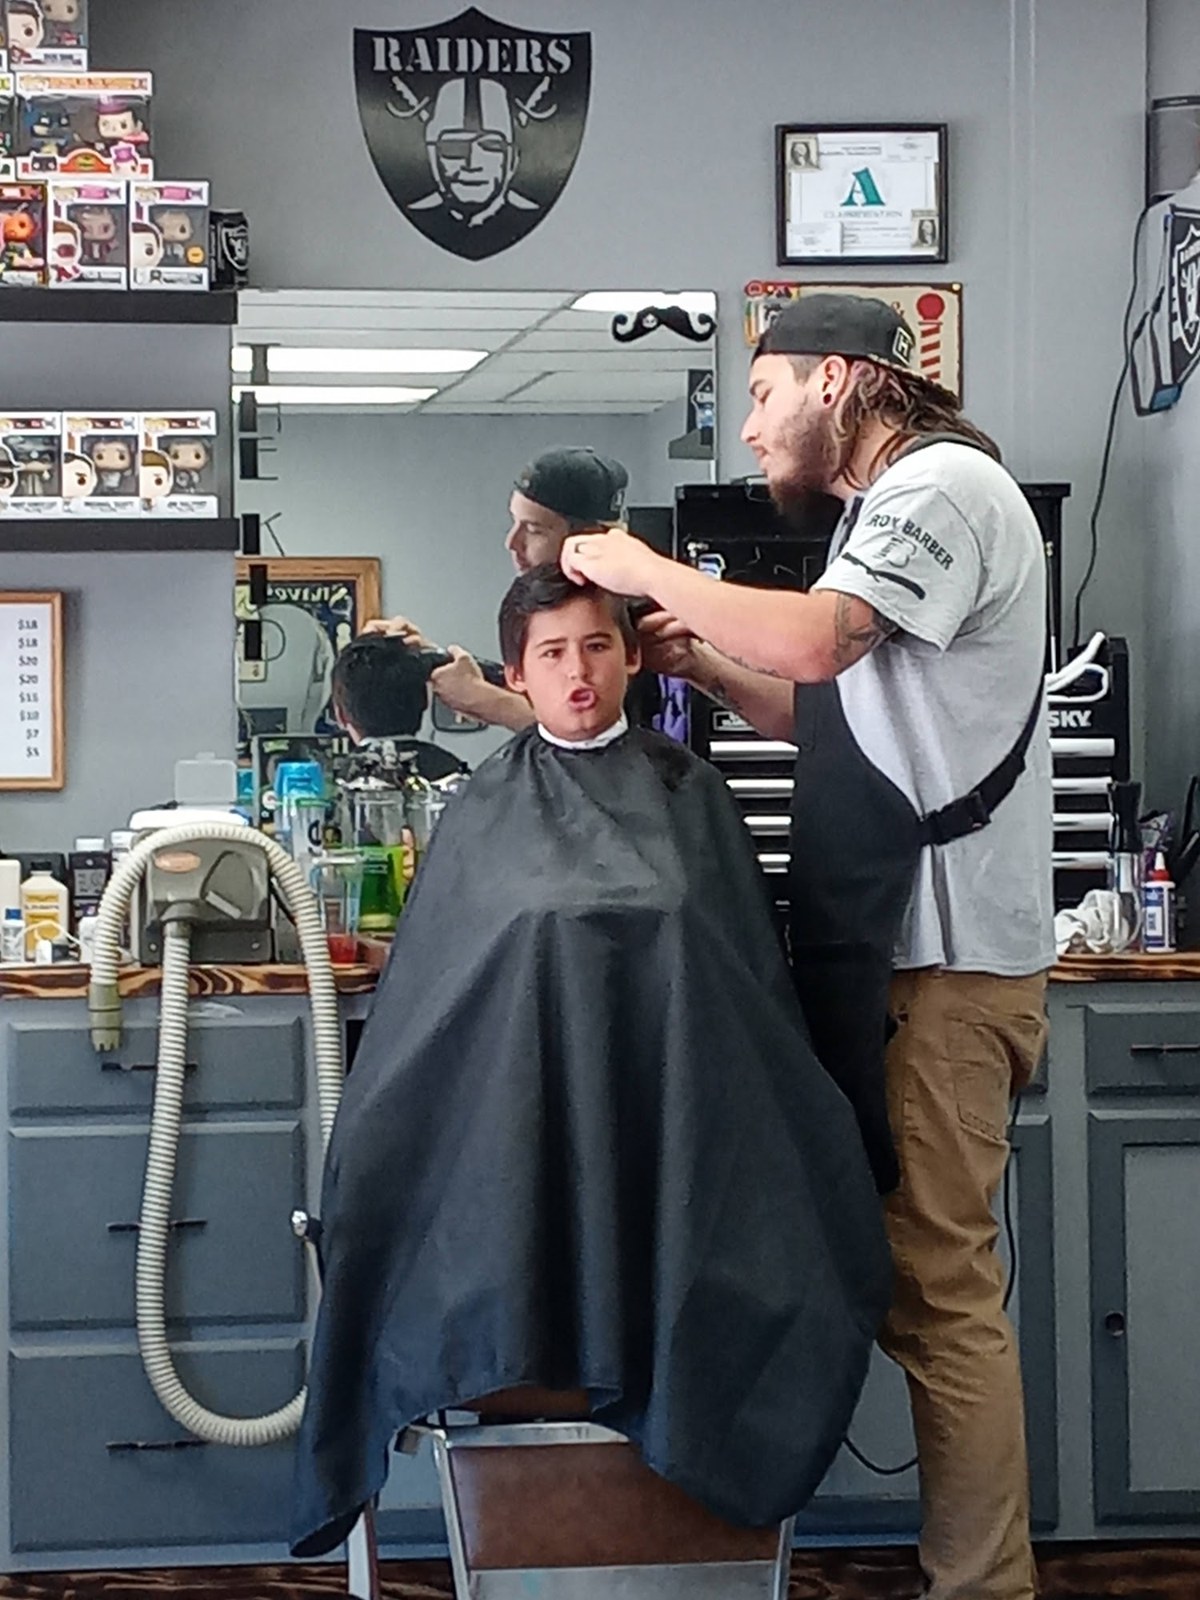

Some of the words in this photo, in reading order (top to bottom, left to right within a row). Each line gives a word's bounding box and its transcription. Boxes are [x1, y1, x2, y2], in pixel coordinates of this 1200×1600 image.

[372, 37, 572, 74] RAIDERS
[902, 517, 954, 570] BARBER
[18, 673, 39, 686] $20
